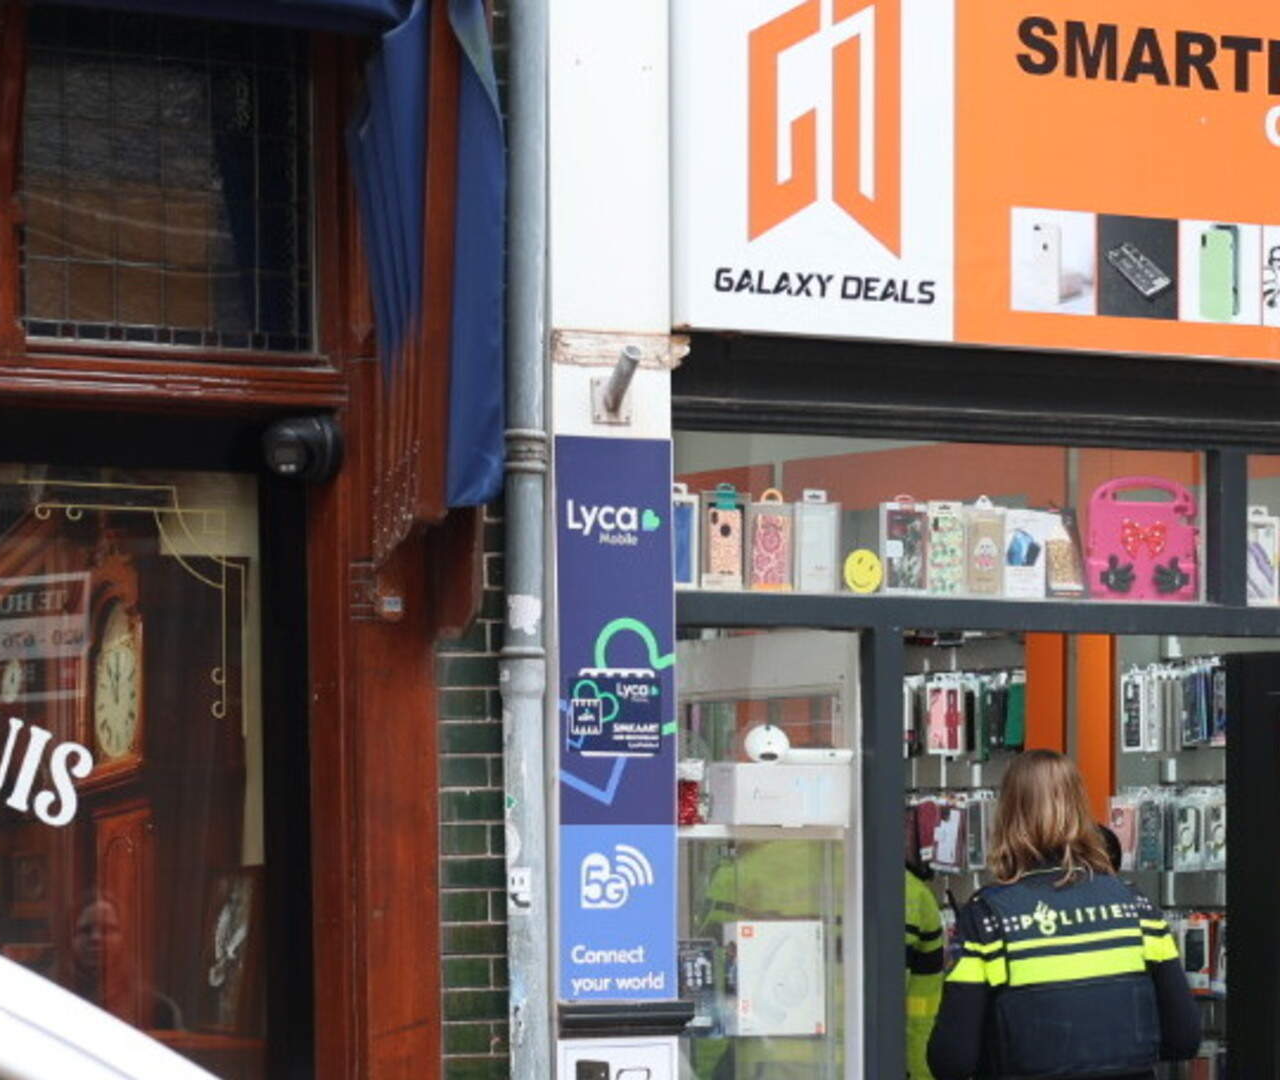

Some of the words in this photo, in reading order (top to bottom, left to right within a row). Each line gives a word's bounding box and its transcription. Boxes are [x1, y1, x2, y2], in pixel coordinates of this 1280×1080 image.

[714, 268, 834, 298] GALAXY
[841, 275, 936, 305] DEALS
[567, 499, 638, 536] Lyca
[599, 532, 638, 546] Mobile
[615, 682, 649, 700] Lyca
[581, 852, 629, 909] 5G
[572, 944, 644, 965] Connect
[571, 976, 611, 996] your
[616, 971, 665, 990] world
